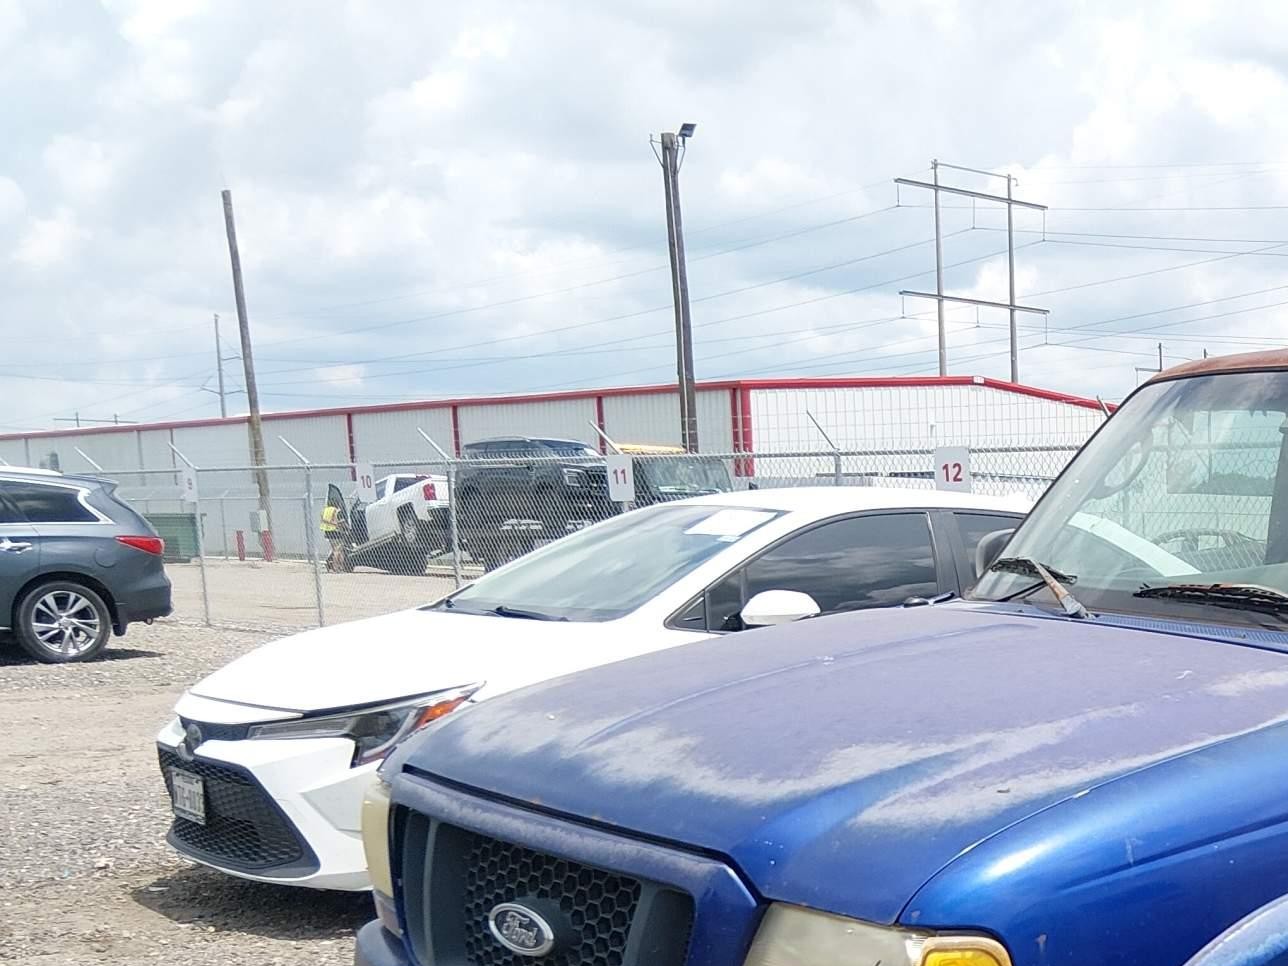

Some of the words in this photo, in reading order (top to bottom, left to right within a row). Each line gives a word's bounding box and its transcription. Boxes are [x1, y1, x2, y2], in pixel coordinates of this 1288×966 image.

[613, 468, 627, 484] 11
[942, 462, 963, 482] 12
[361, 475, 372, 488] 10
[502, 911, 538, 947] Ford
